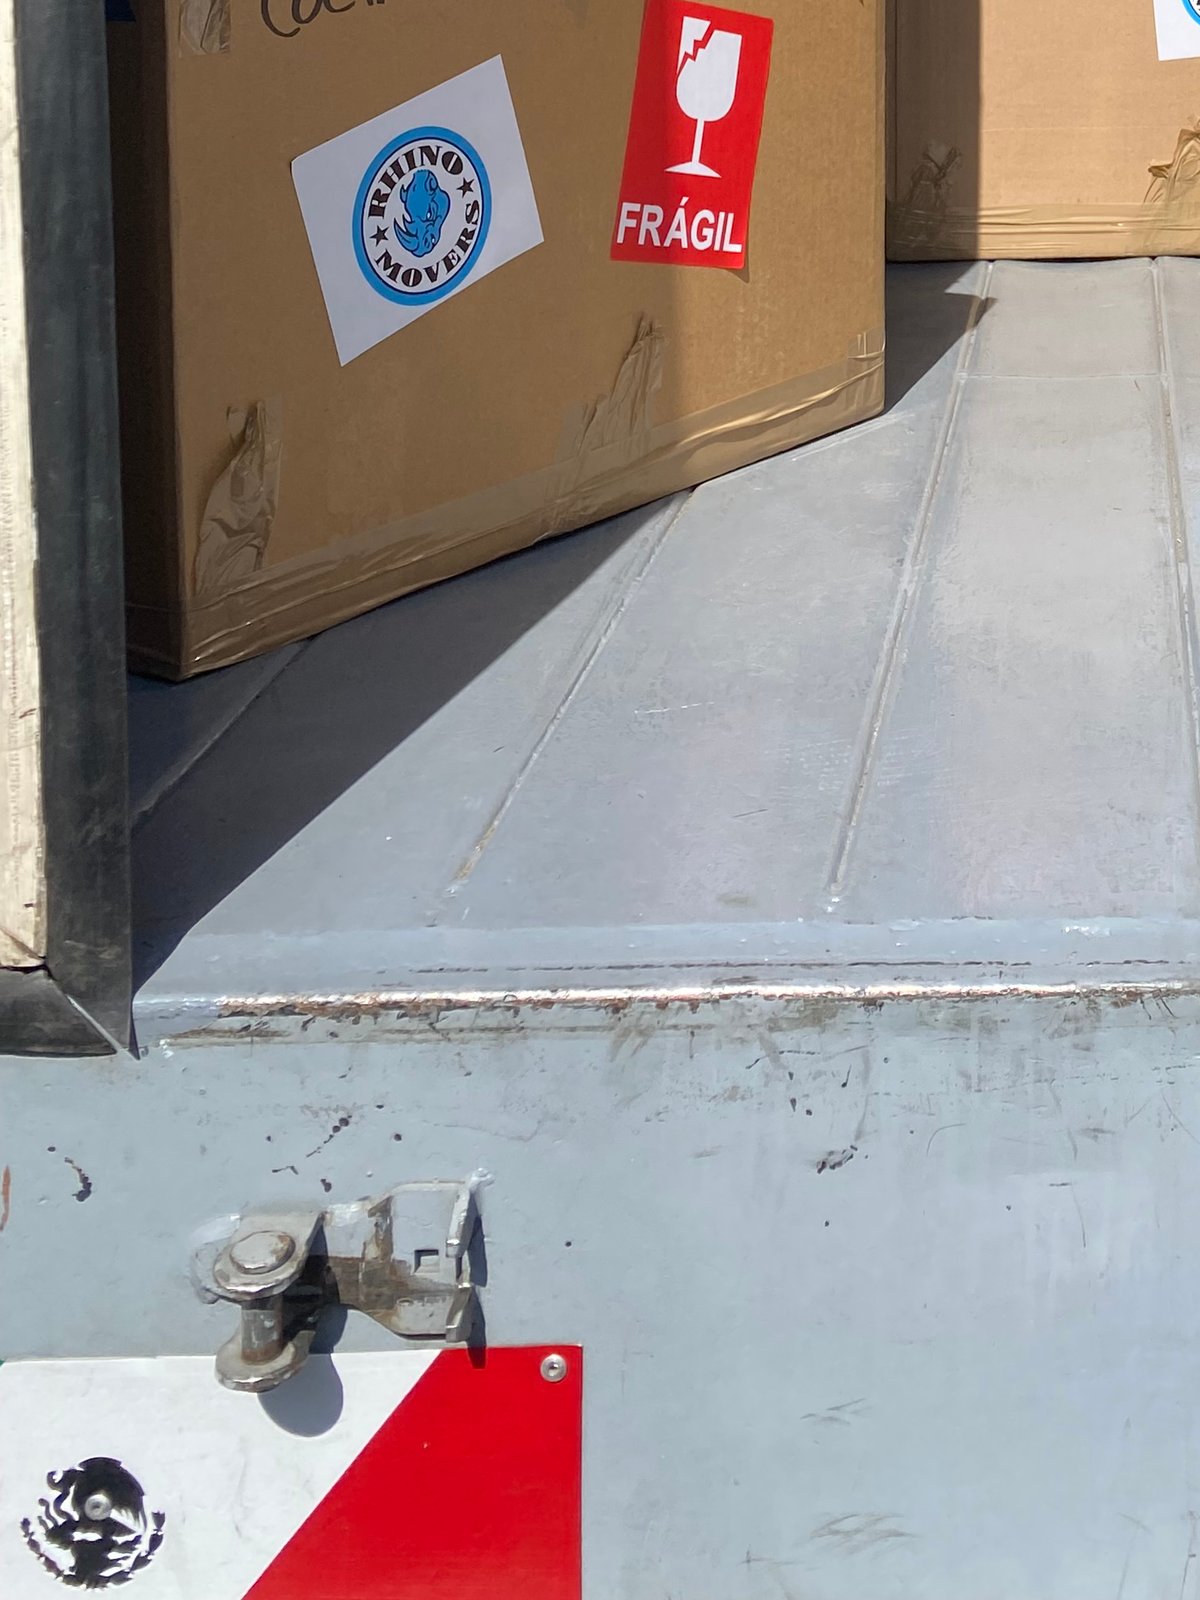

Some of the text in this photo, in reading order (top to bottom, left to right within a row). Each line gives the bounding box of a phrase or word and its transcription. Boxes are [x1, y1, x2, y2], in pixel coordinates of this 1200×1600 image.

[368, 145, 463, 220] RHINO
[374, 199, 480, 287] MOVERS
[616, 196, 743, 256] FRÁGIL
